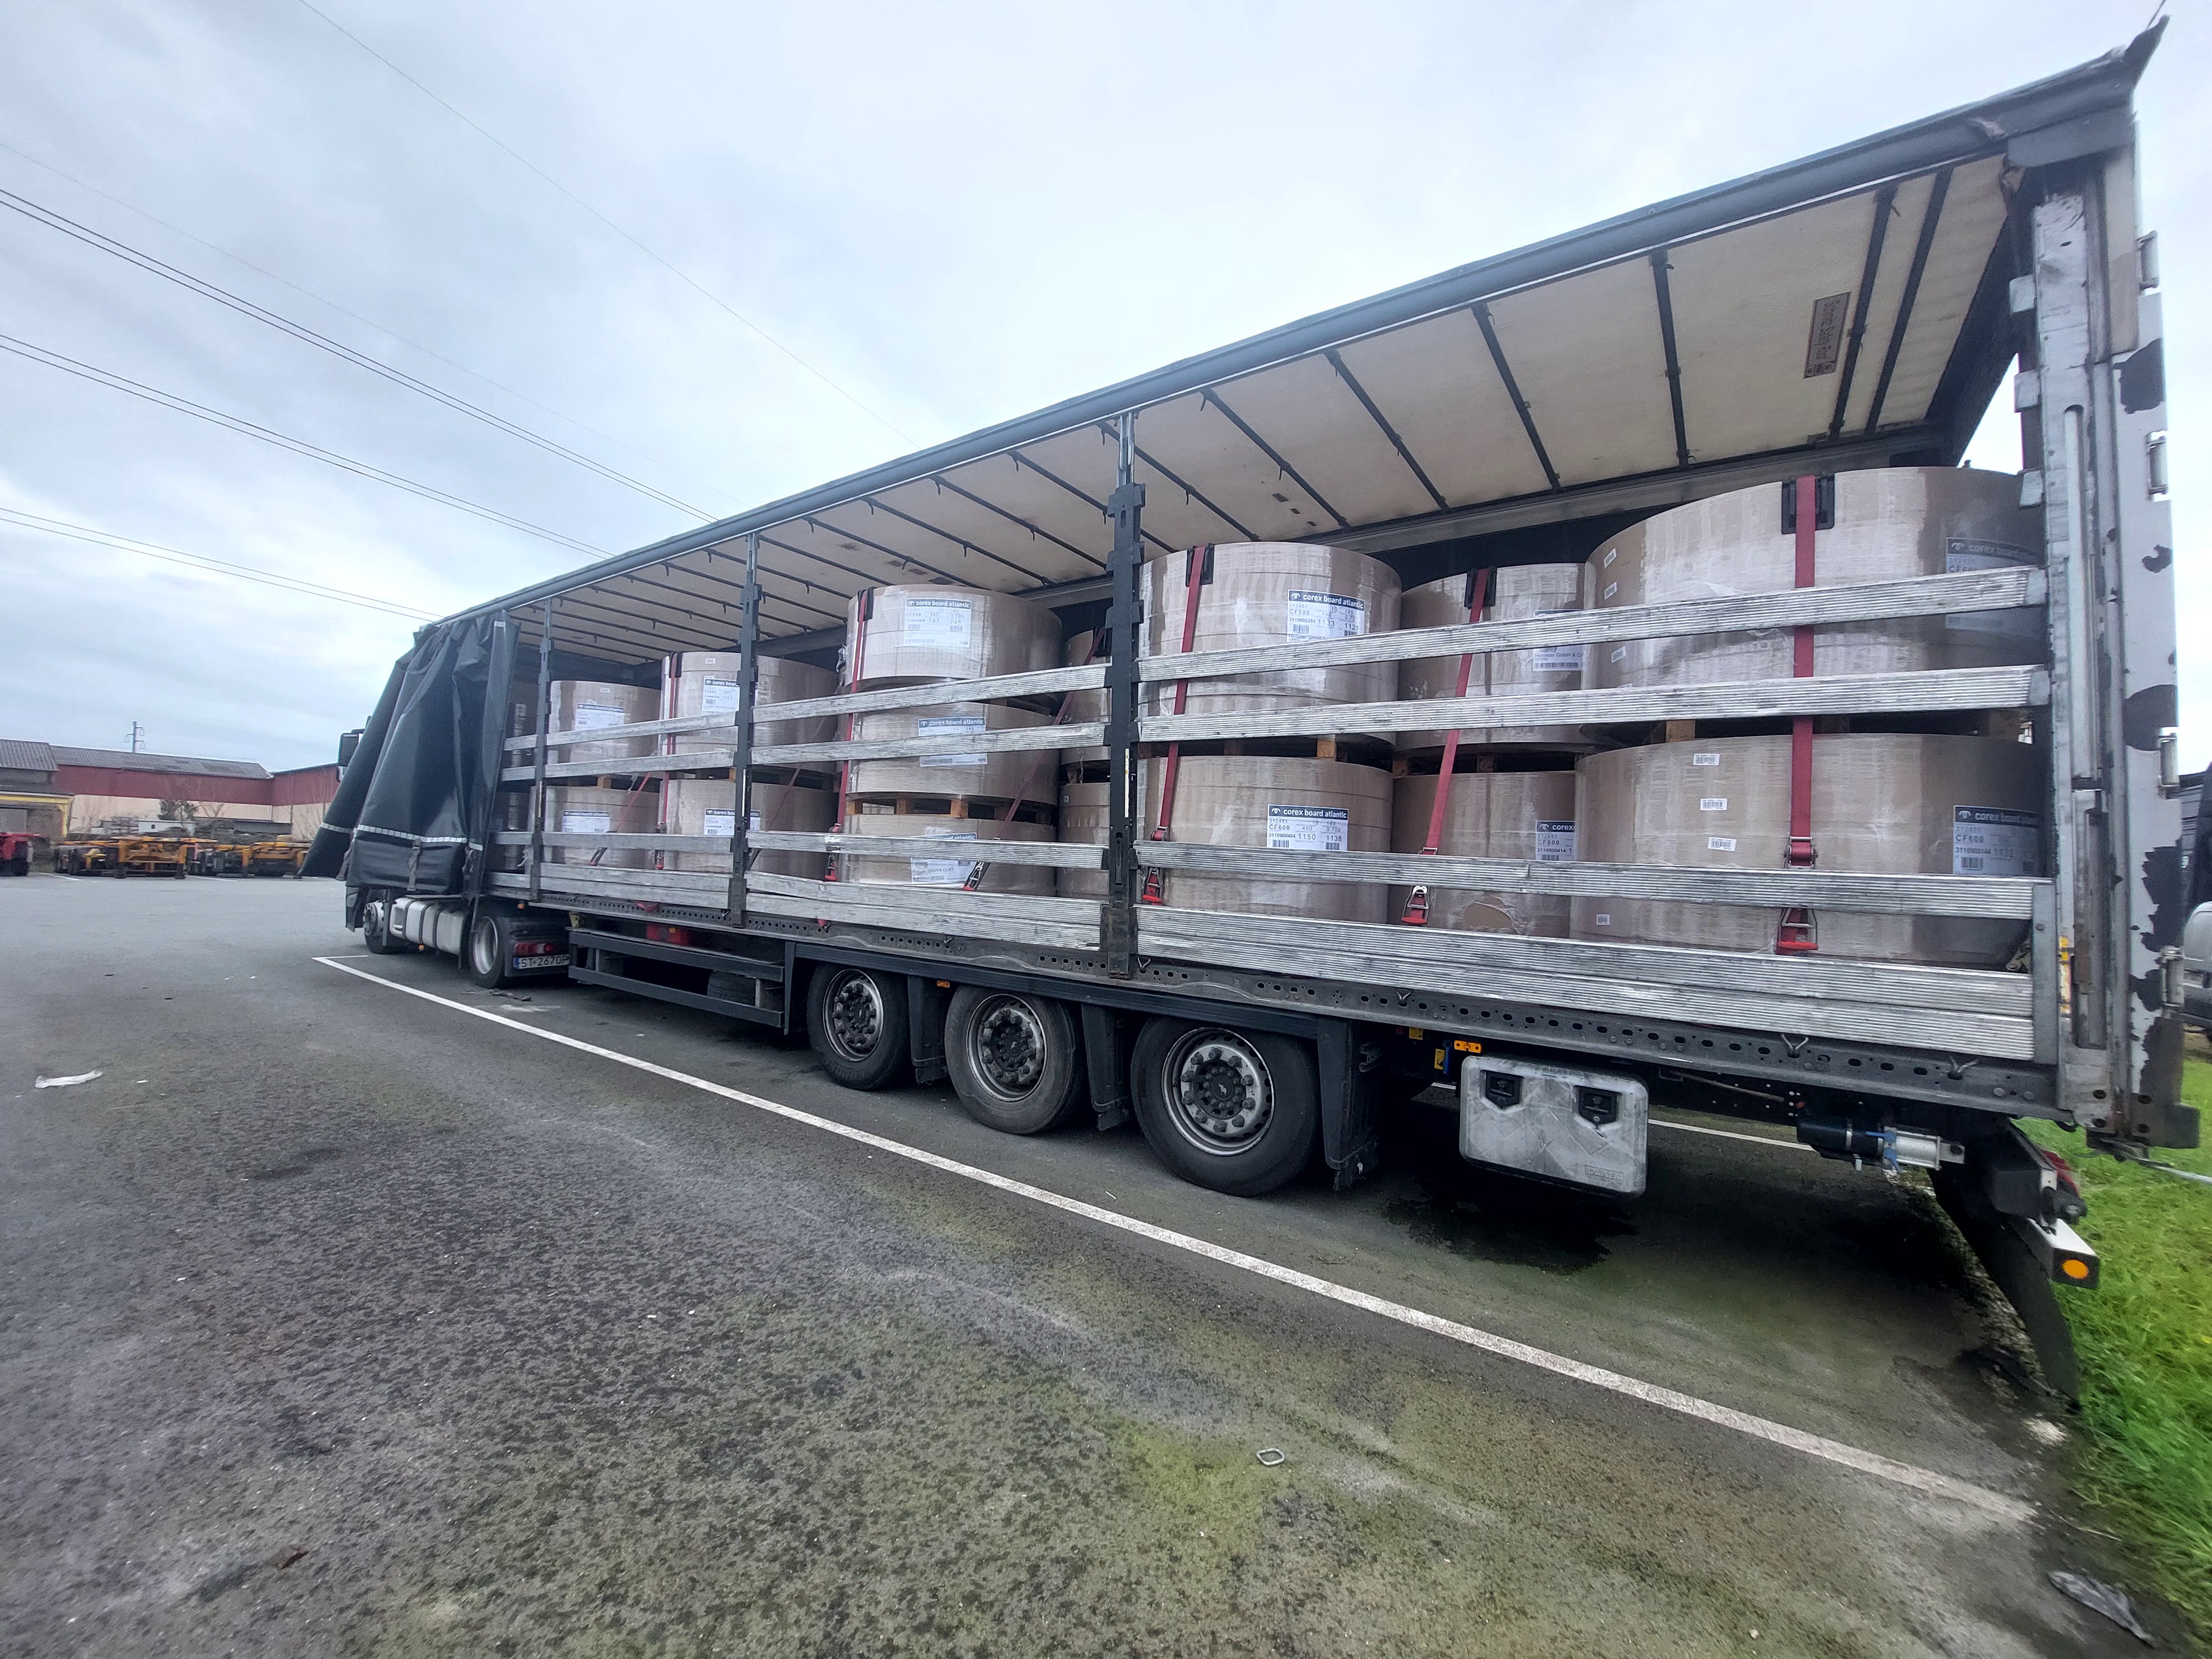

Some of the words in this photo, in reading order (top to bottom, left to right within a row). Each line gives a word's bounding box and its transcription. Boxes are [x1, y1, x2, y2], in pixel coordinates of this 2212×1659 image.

[1323, 596, 1342, 604] board
[1343, 599, 1364, 609] atlantic
[1305, 808, 1323, 817] board
[1324, 810, 1347, 818] atlantic
[1975, 812, 2000, 821] corex
[1955, 834, 1984, 843] CF600
[521, 958, 533, 968] ST
